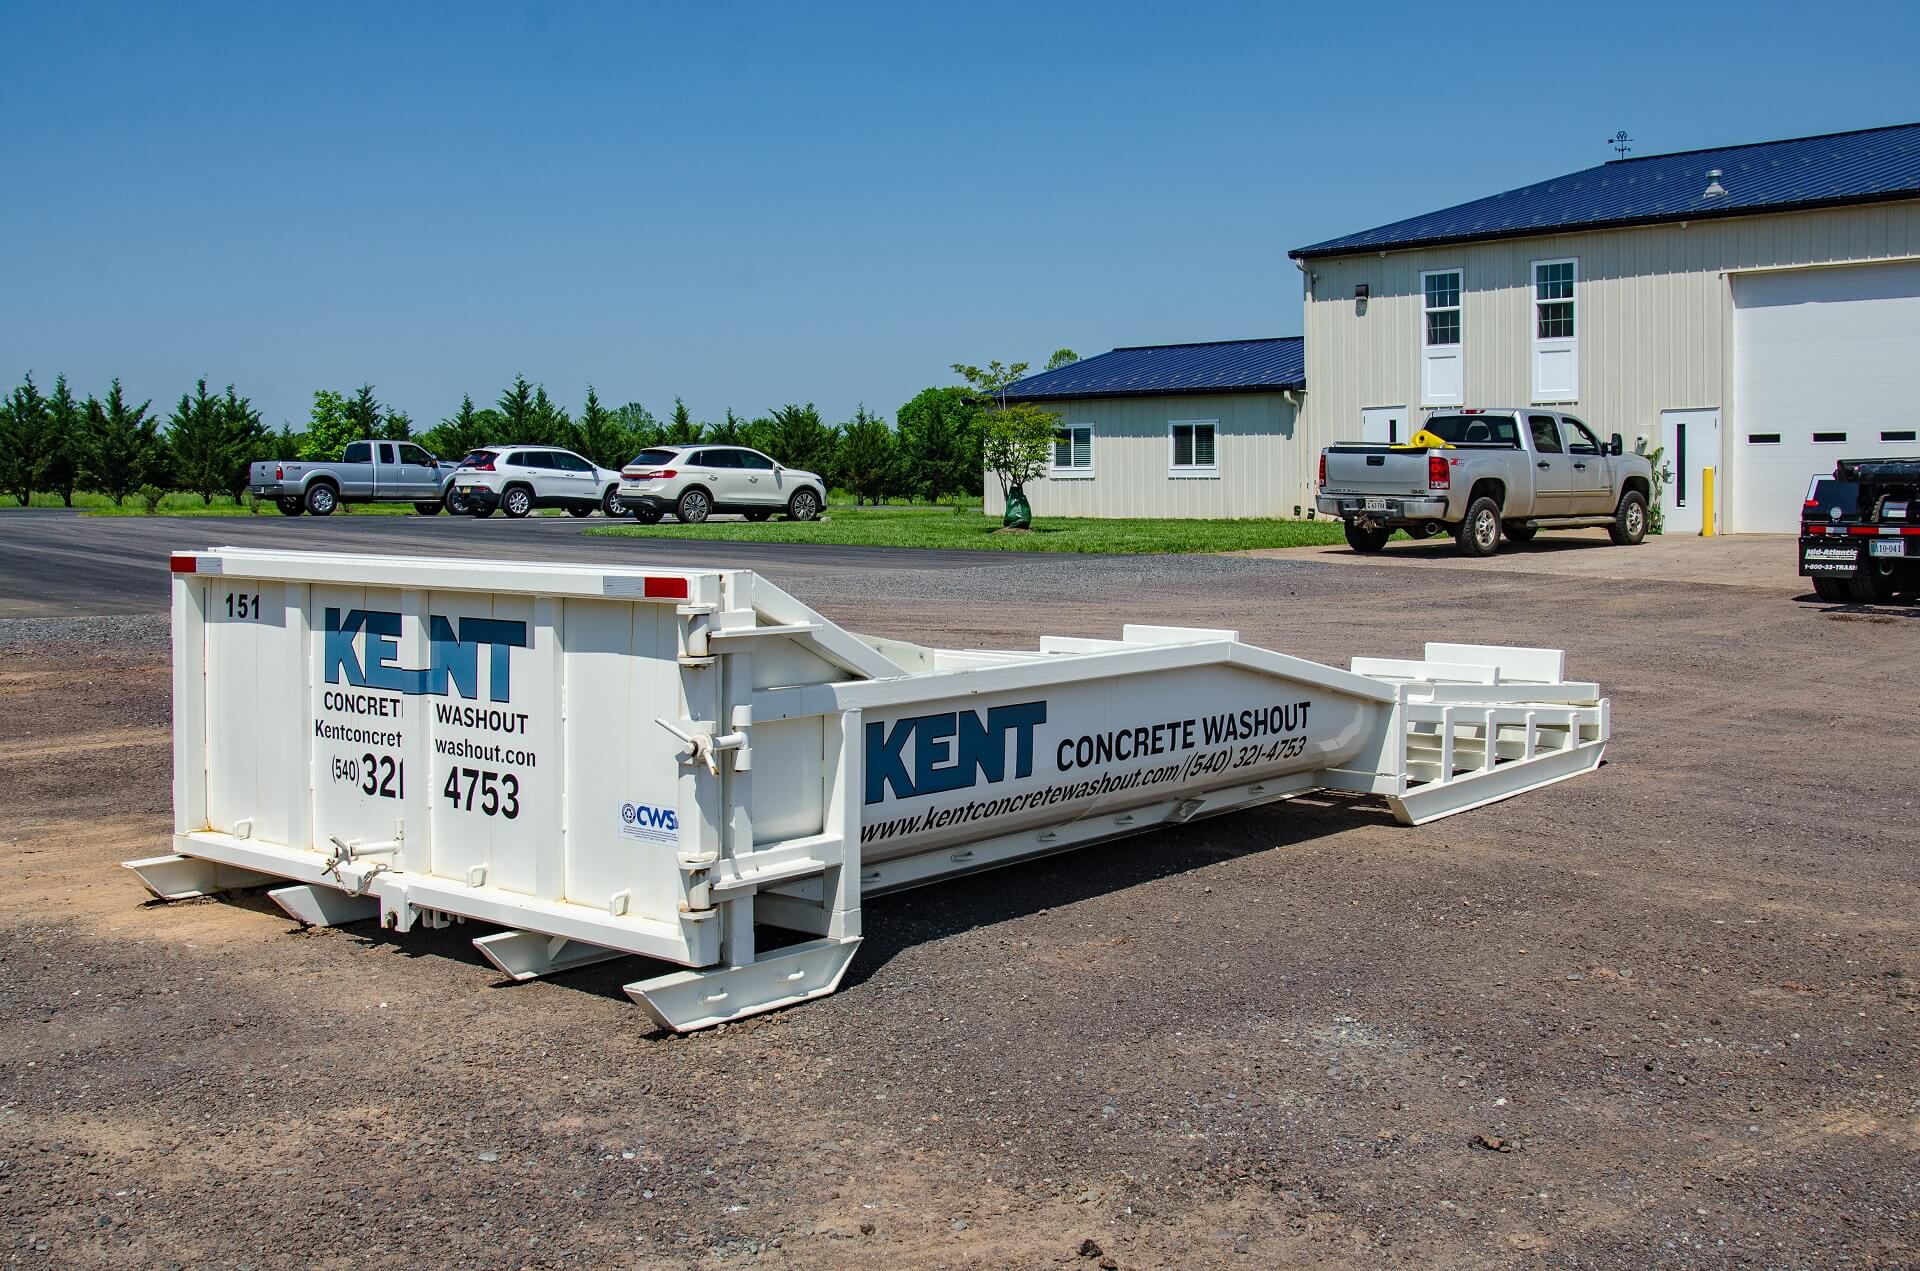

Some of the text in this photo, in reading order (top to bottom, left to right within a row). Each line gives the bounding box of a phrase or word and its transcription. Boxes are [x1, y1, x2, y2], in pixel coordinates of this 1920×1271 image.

[226, 592, 260, 620] 151
[324, 607, 527, 704] KENT
[323, 690, 529, 735] CONCRET WASHOUT
[1056, 701, 1311, 772] CONCRETE WASHOUT
[864, 700, 1047, 806] KENT
[1232, 735, 1307, 769] 321-4753
[331, 753, 360, 788] (540)
[443, 765, 520, 820] 4753
